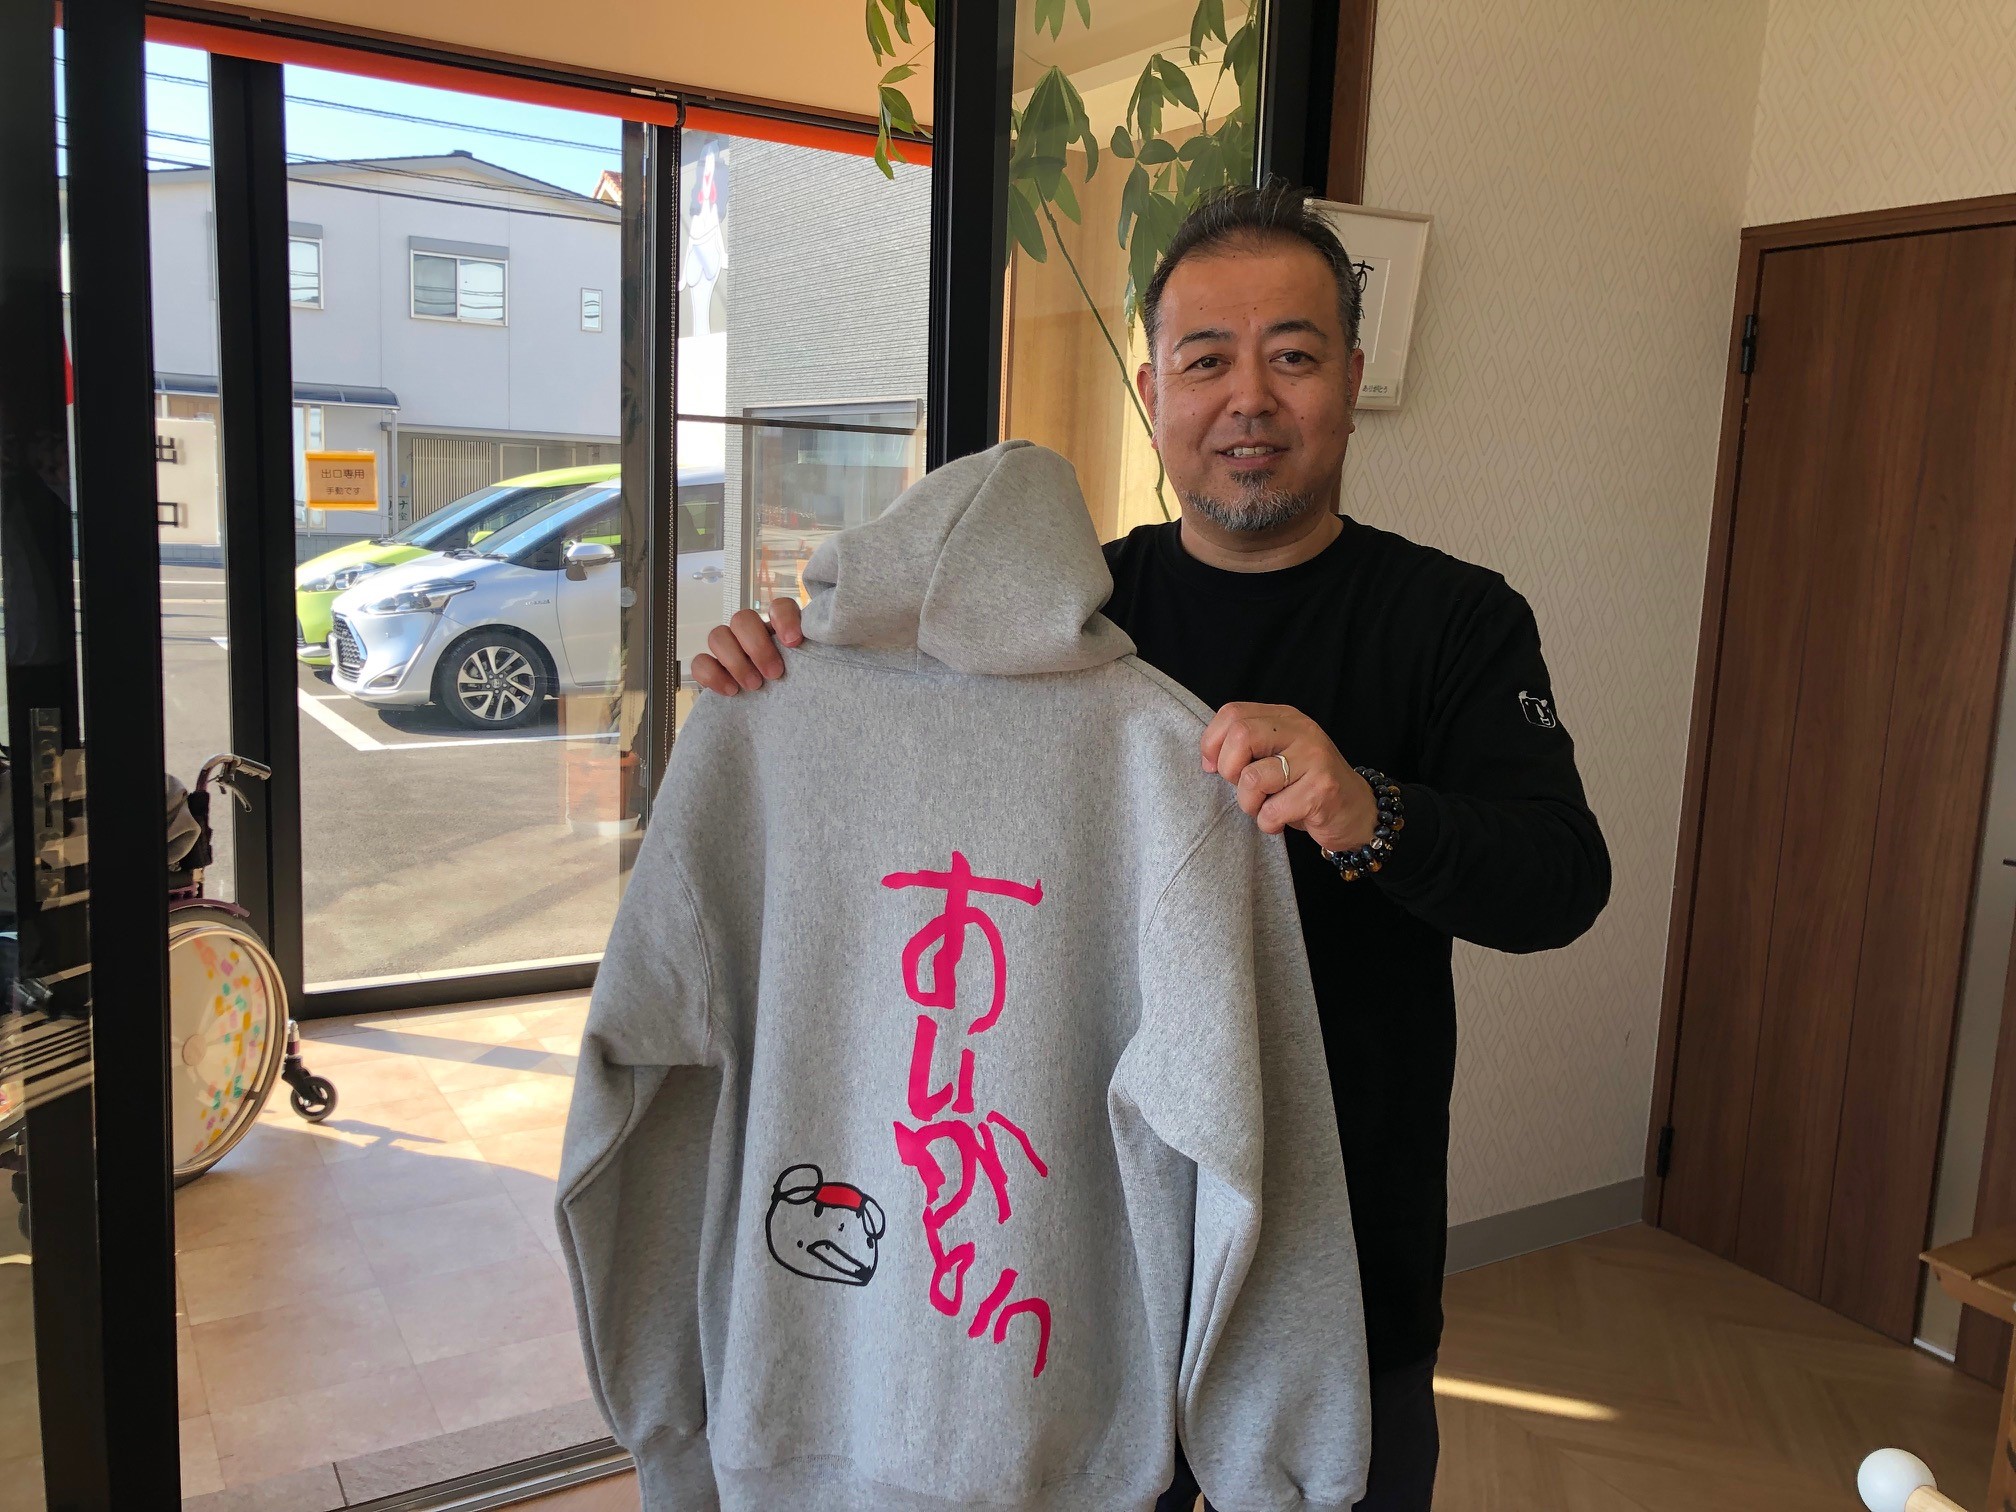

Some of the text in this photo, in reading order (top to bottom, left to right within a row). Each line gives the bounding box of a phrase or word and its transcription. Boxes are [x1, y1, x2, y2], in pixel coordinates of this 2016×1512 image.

[321, 469, 365, 479] 出口専用
[326, 486, 361, 495] 手動です
